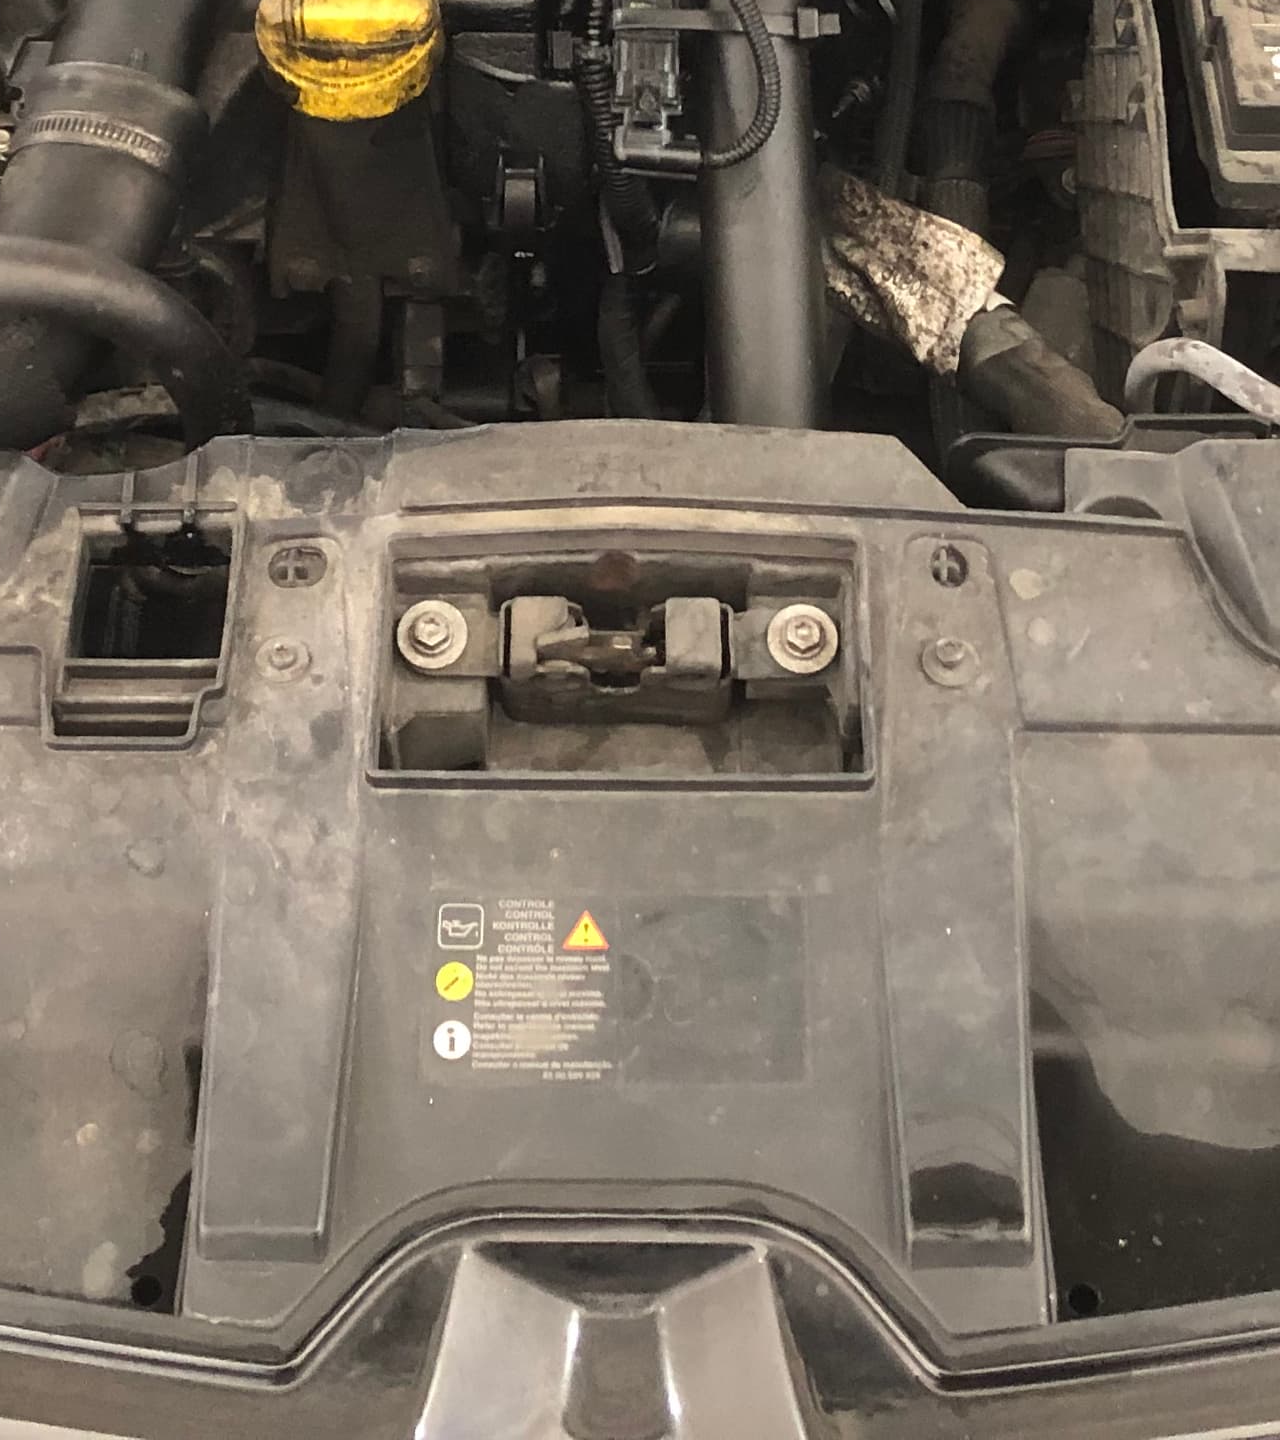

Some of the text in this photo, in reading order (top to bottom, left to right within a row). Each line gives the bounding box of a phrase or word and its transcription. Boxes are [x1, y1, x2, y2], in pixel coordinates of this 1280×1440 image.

[505, 910, 555, 920] CONTROL
[493, 921, 554, 931] KONTROLLE
[504, 932, 554, 942] CONTROL
